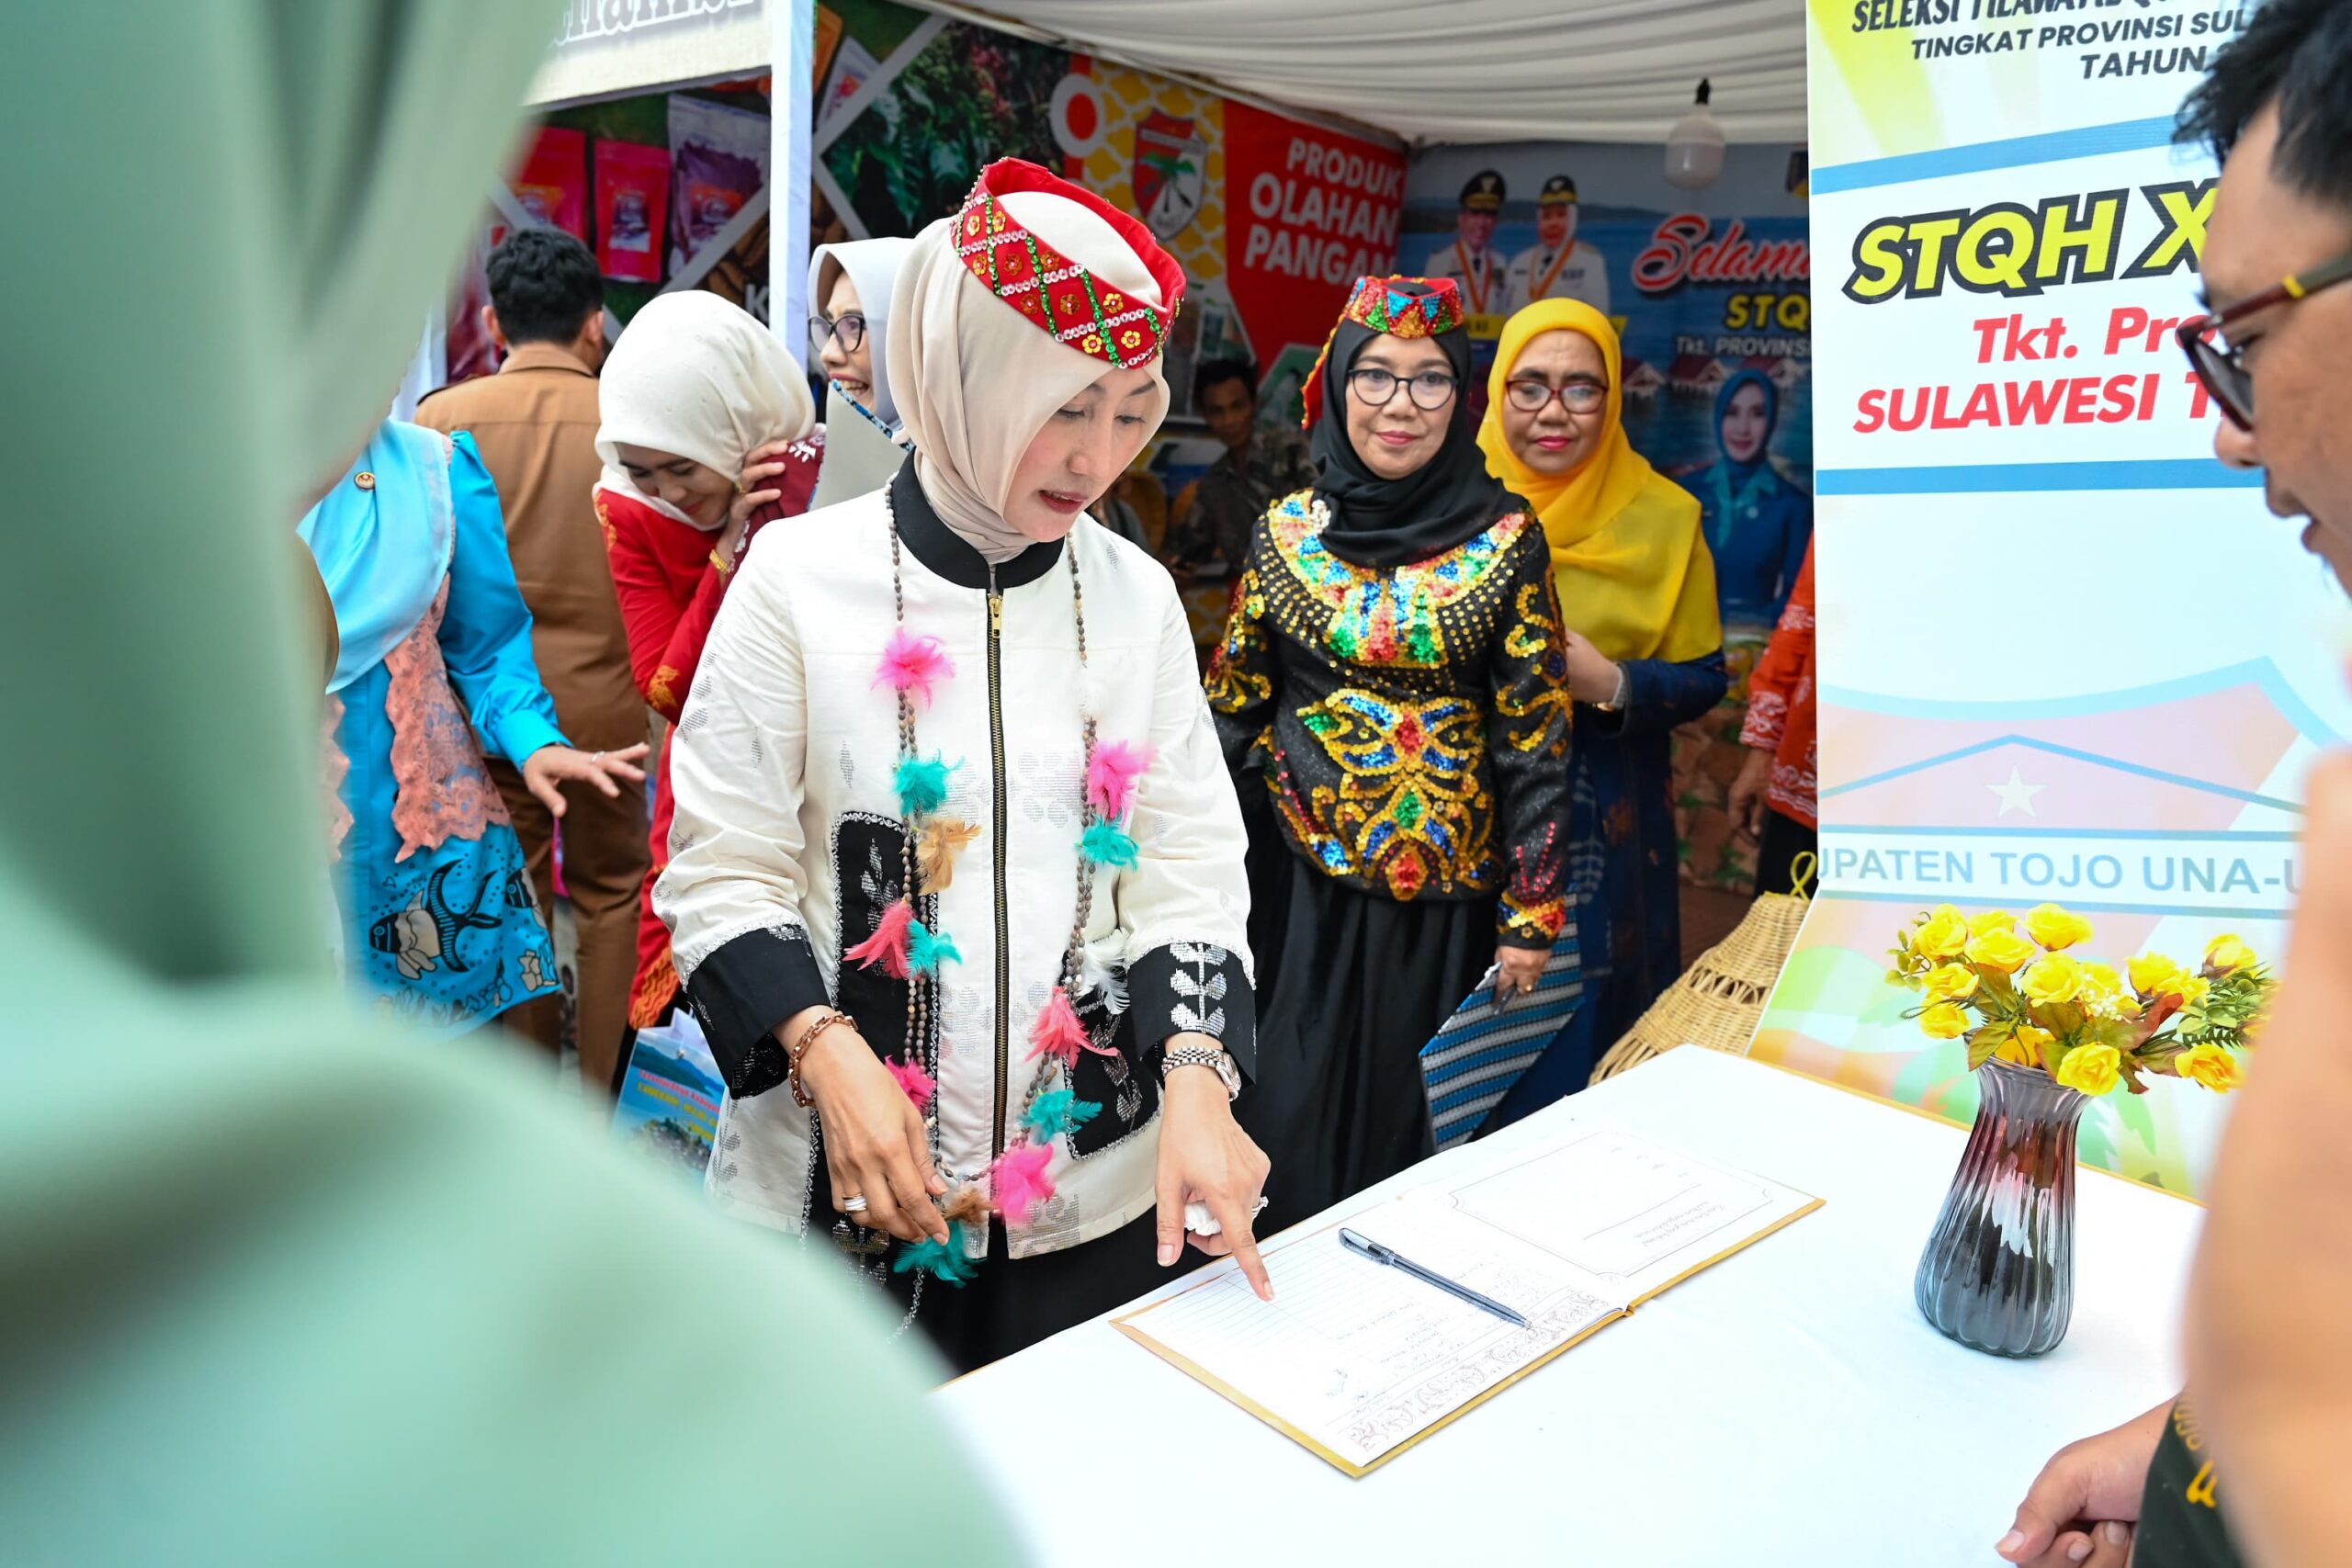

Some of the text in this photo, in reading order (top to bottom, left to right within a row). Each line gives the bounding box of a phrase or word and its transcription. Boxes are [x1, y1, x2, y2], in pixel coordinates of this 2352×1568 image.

[1852, 0, 1961, 32] SELEKSI
[1911, 28, 2033, 60] TINGKAT
[2038, 14, 2183, 49] PROVINSI
[2190, 8, 2249, 35] SUL
[2079, 46, 2207, 80] TAHUN
[1287, 137, 1402, 199] PRODUK
[1250, 172, 1400, 247] OLAHAN
[1245, 223, 1397, 287] PANGAN
[1841, 187, 2130, 304] STQH
[1725, 293, 1810, 331] STQ
[1714, 336, 1810, 356] PROVINS
[1973, 314, 2078, 364] Tkt.
[1852, 373, 2161, 434] SULAWESI
[1990, 852, 2123, 888] TOJO
